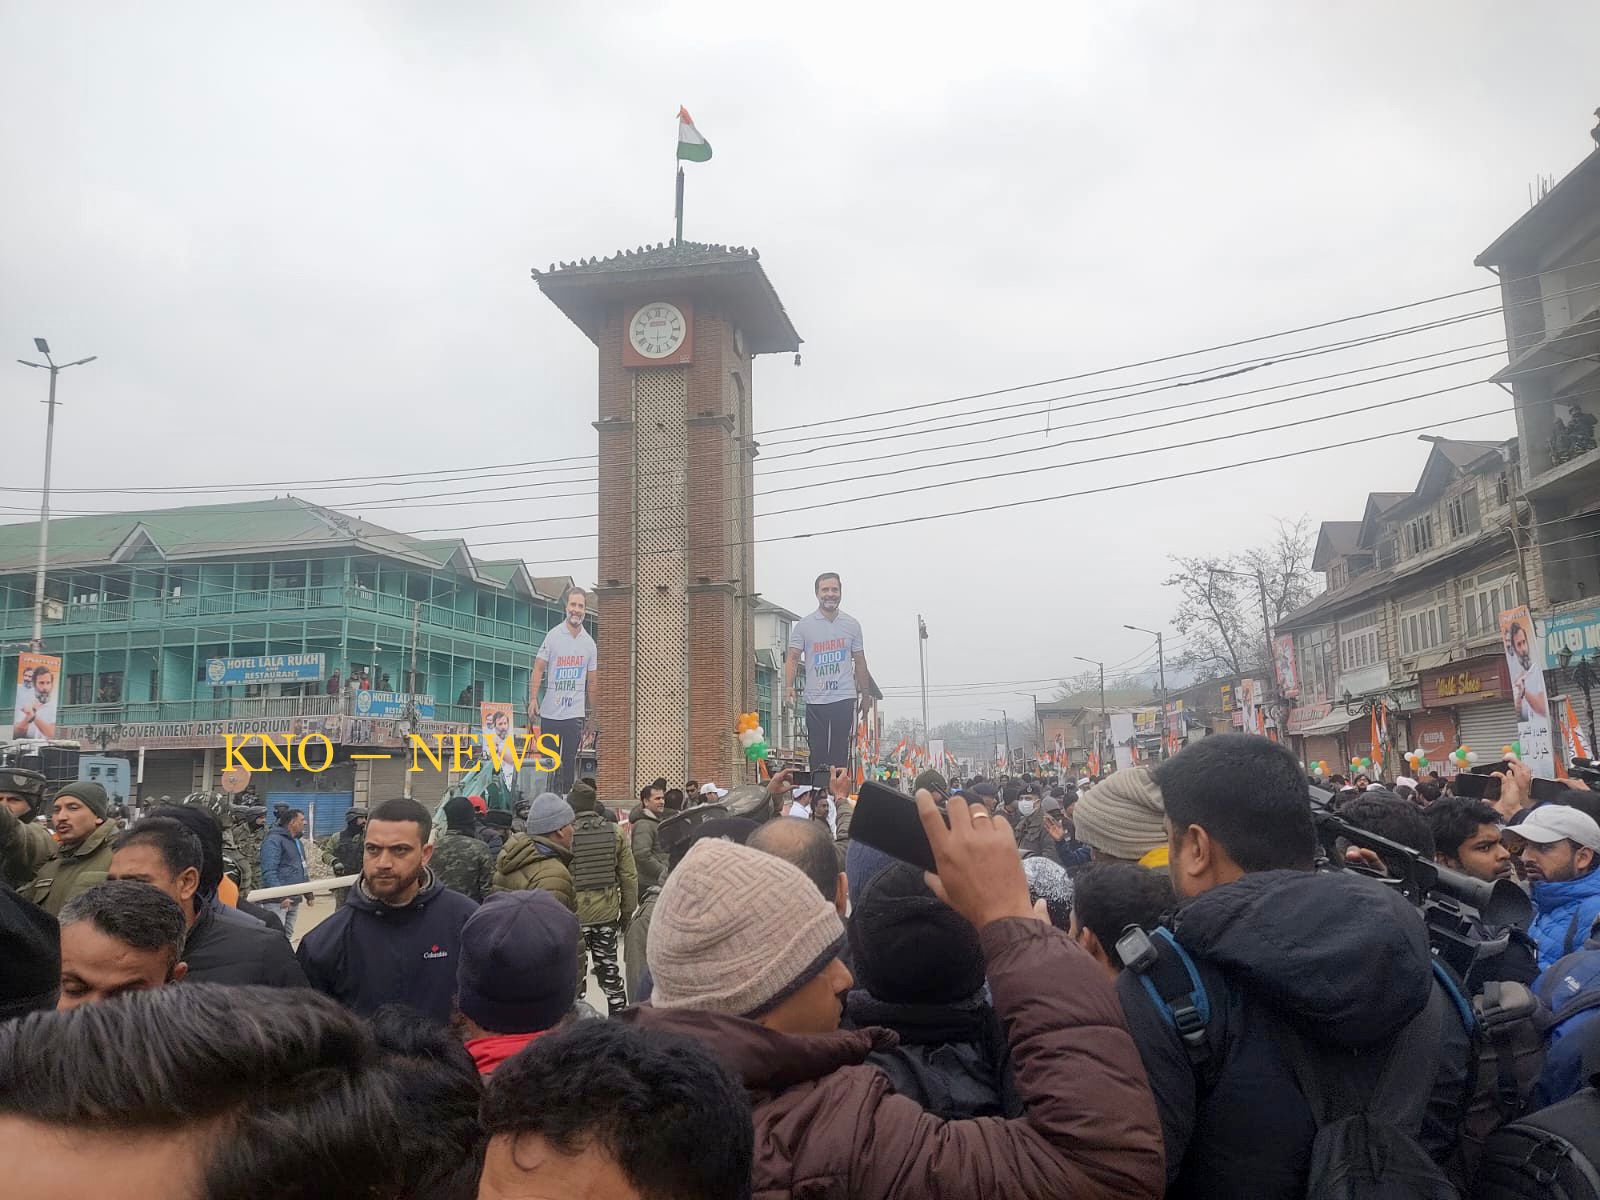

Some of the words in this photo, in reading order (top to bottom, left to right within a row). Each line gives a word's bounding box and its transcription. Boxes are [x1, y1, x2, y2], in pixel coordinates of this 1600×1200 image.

[812, 639, 846, 653] BHARAT
[227, 658, 256, 670] HOTEL
[258, 656, 284, 668] LALA
[287, 653, 319, 666] RUKH
[556, 655, 585, 667] BHARAT
[817, 651, 842, 665] JODO
[244, 669, 300, 680] RESTAURANT
[558, 668, 579, 680] JODO
[814, 663, 841, 677] YATRA
[554, 680, 577, 691] YATRA
[373, 692, 394, 703] HOTEL
[121, 724, 194, 738] GOVERNMENT
[196, 723, 224, 736] ARTS
[227, 720, 291, 734] EMPORIUM
